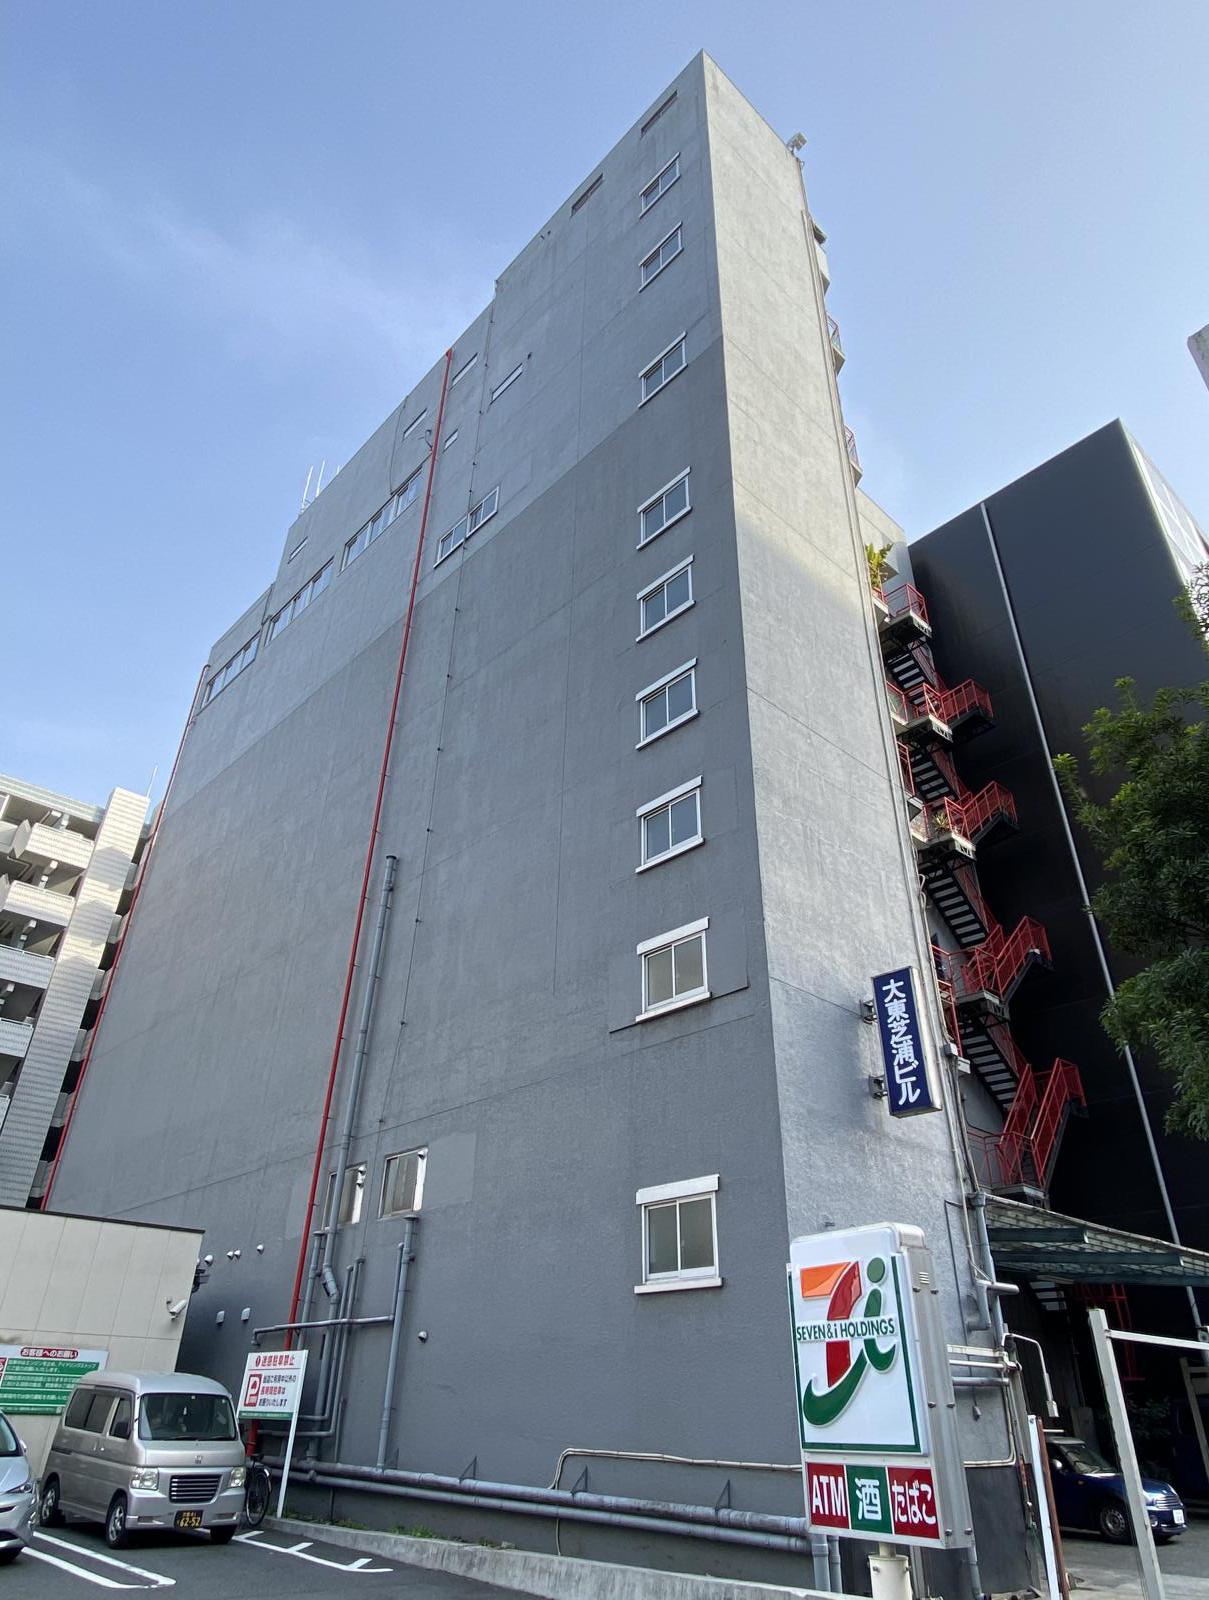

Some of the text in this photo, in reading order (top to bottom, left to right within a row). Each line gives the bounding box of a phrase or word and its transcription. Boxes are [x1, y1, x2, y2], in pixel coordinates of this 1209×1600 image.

[882, 978, 920, 1106] 大東芝浦ビル
[840, 1318, 895, 1337] HOLDINGS
[21, 1349, 77, 1358] お客様へのお願い
[811, 1474, 847, 1517] ATM
[855, 1477, 882, 1521] 酒
[891, 1481, 936, 1525] たばこ
